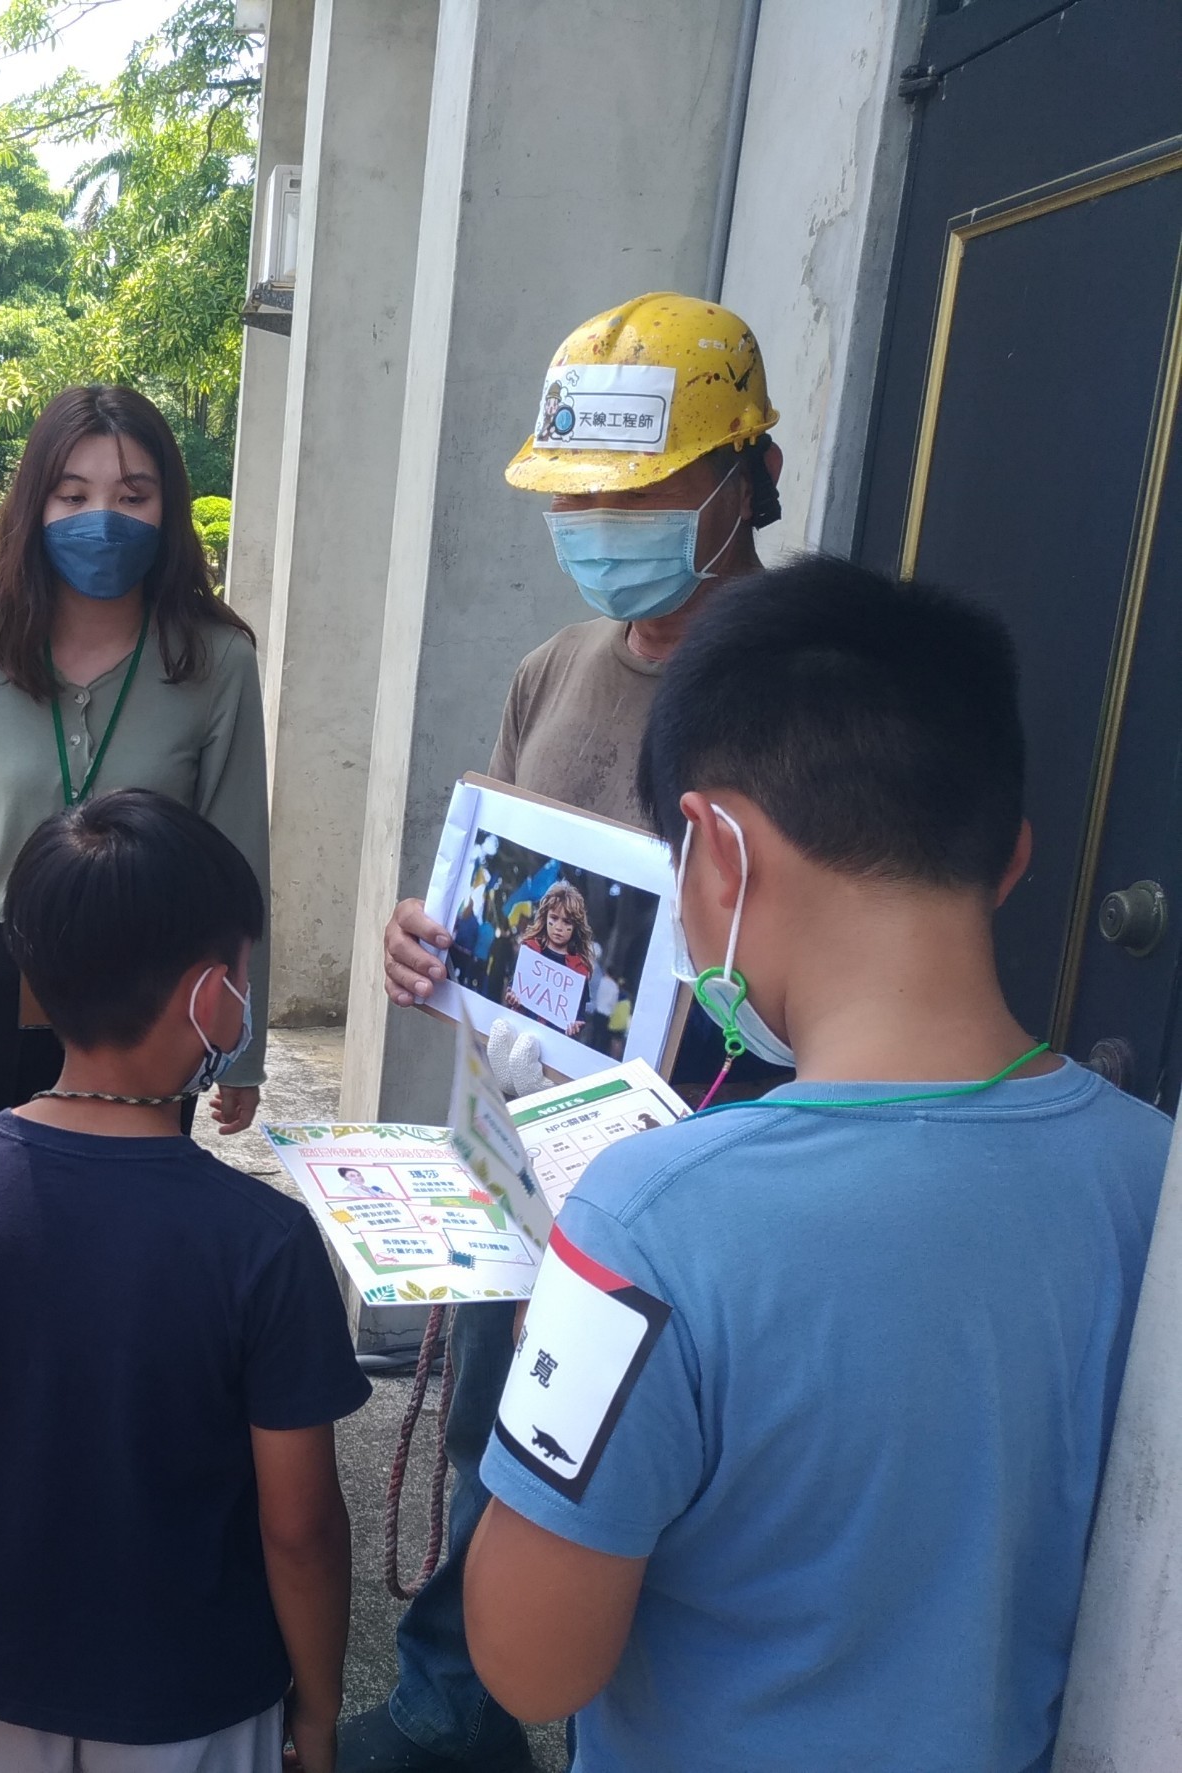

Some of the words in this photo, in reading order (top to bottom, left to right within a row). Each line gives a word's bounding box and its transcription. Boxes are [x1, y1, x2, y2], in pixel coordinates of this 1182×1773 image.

[579, 411, 654, 429] 天線工程師
[532, 960, 574, 991] STOP
[517, 971, 569, 1021] WAR
[538, 1097, 585, 1116] NOTES
